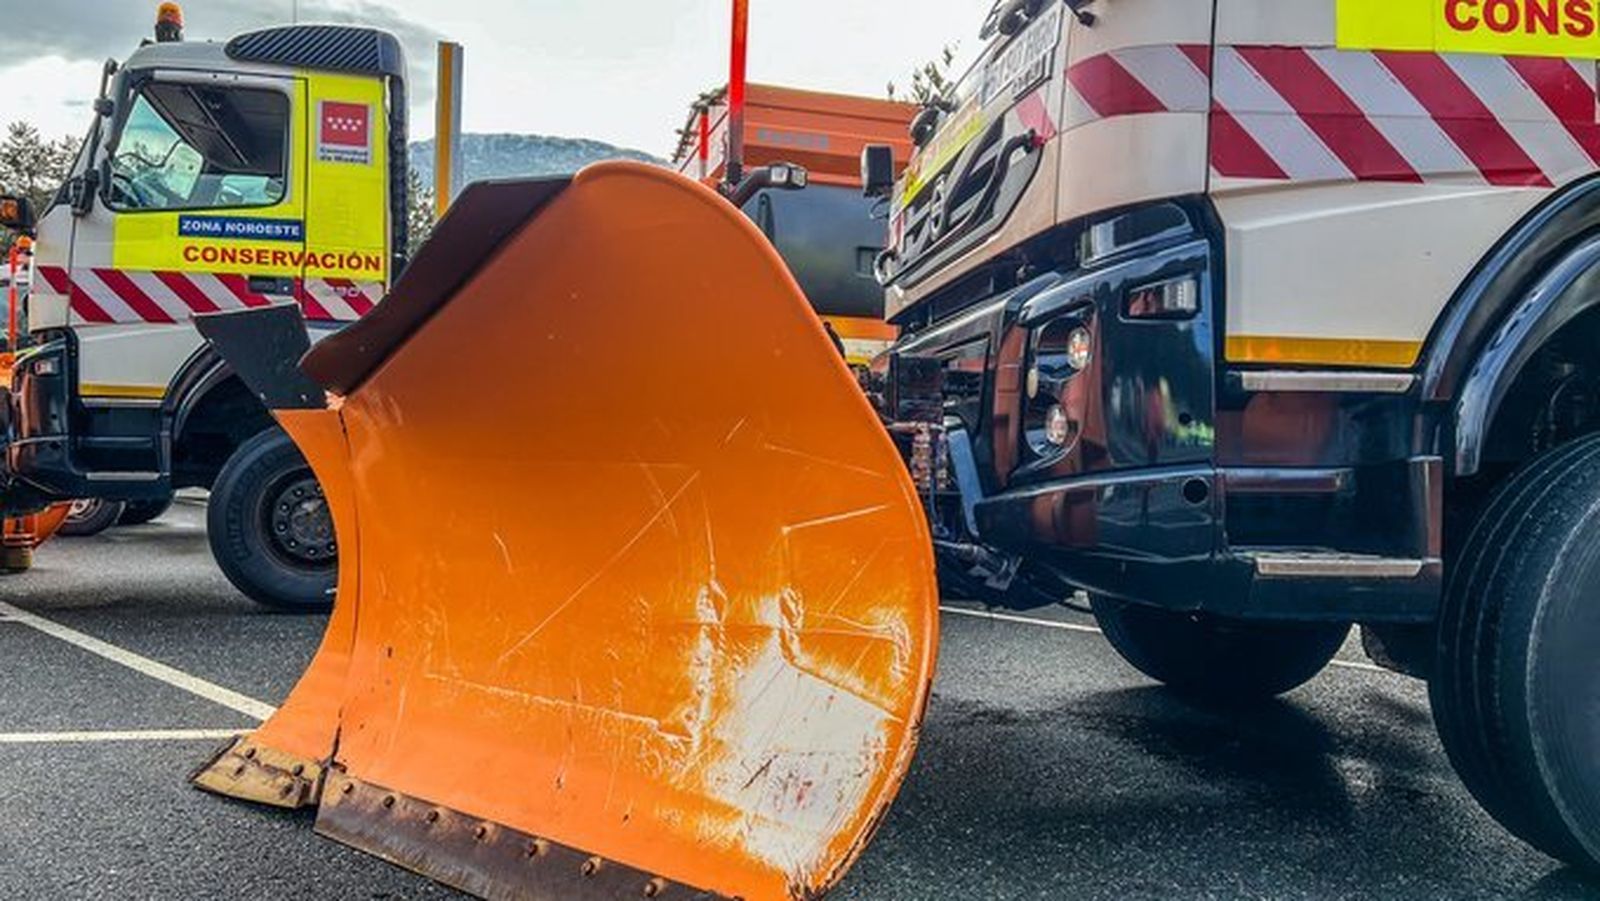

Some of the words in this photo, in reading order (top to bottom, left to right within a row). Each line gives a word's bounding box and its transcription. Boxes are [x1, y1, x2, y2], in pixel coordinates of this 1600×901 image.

[182, 219, 221, 232] ZONA
[225, 222, 300, 236] NOROESTE
[183, 245, 381, 271] CONSERVACIÓN
